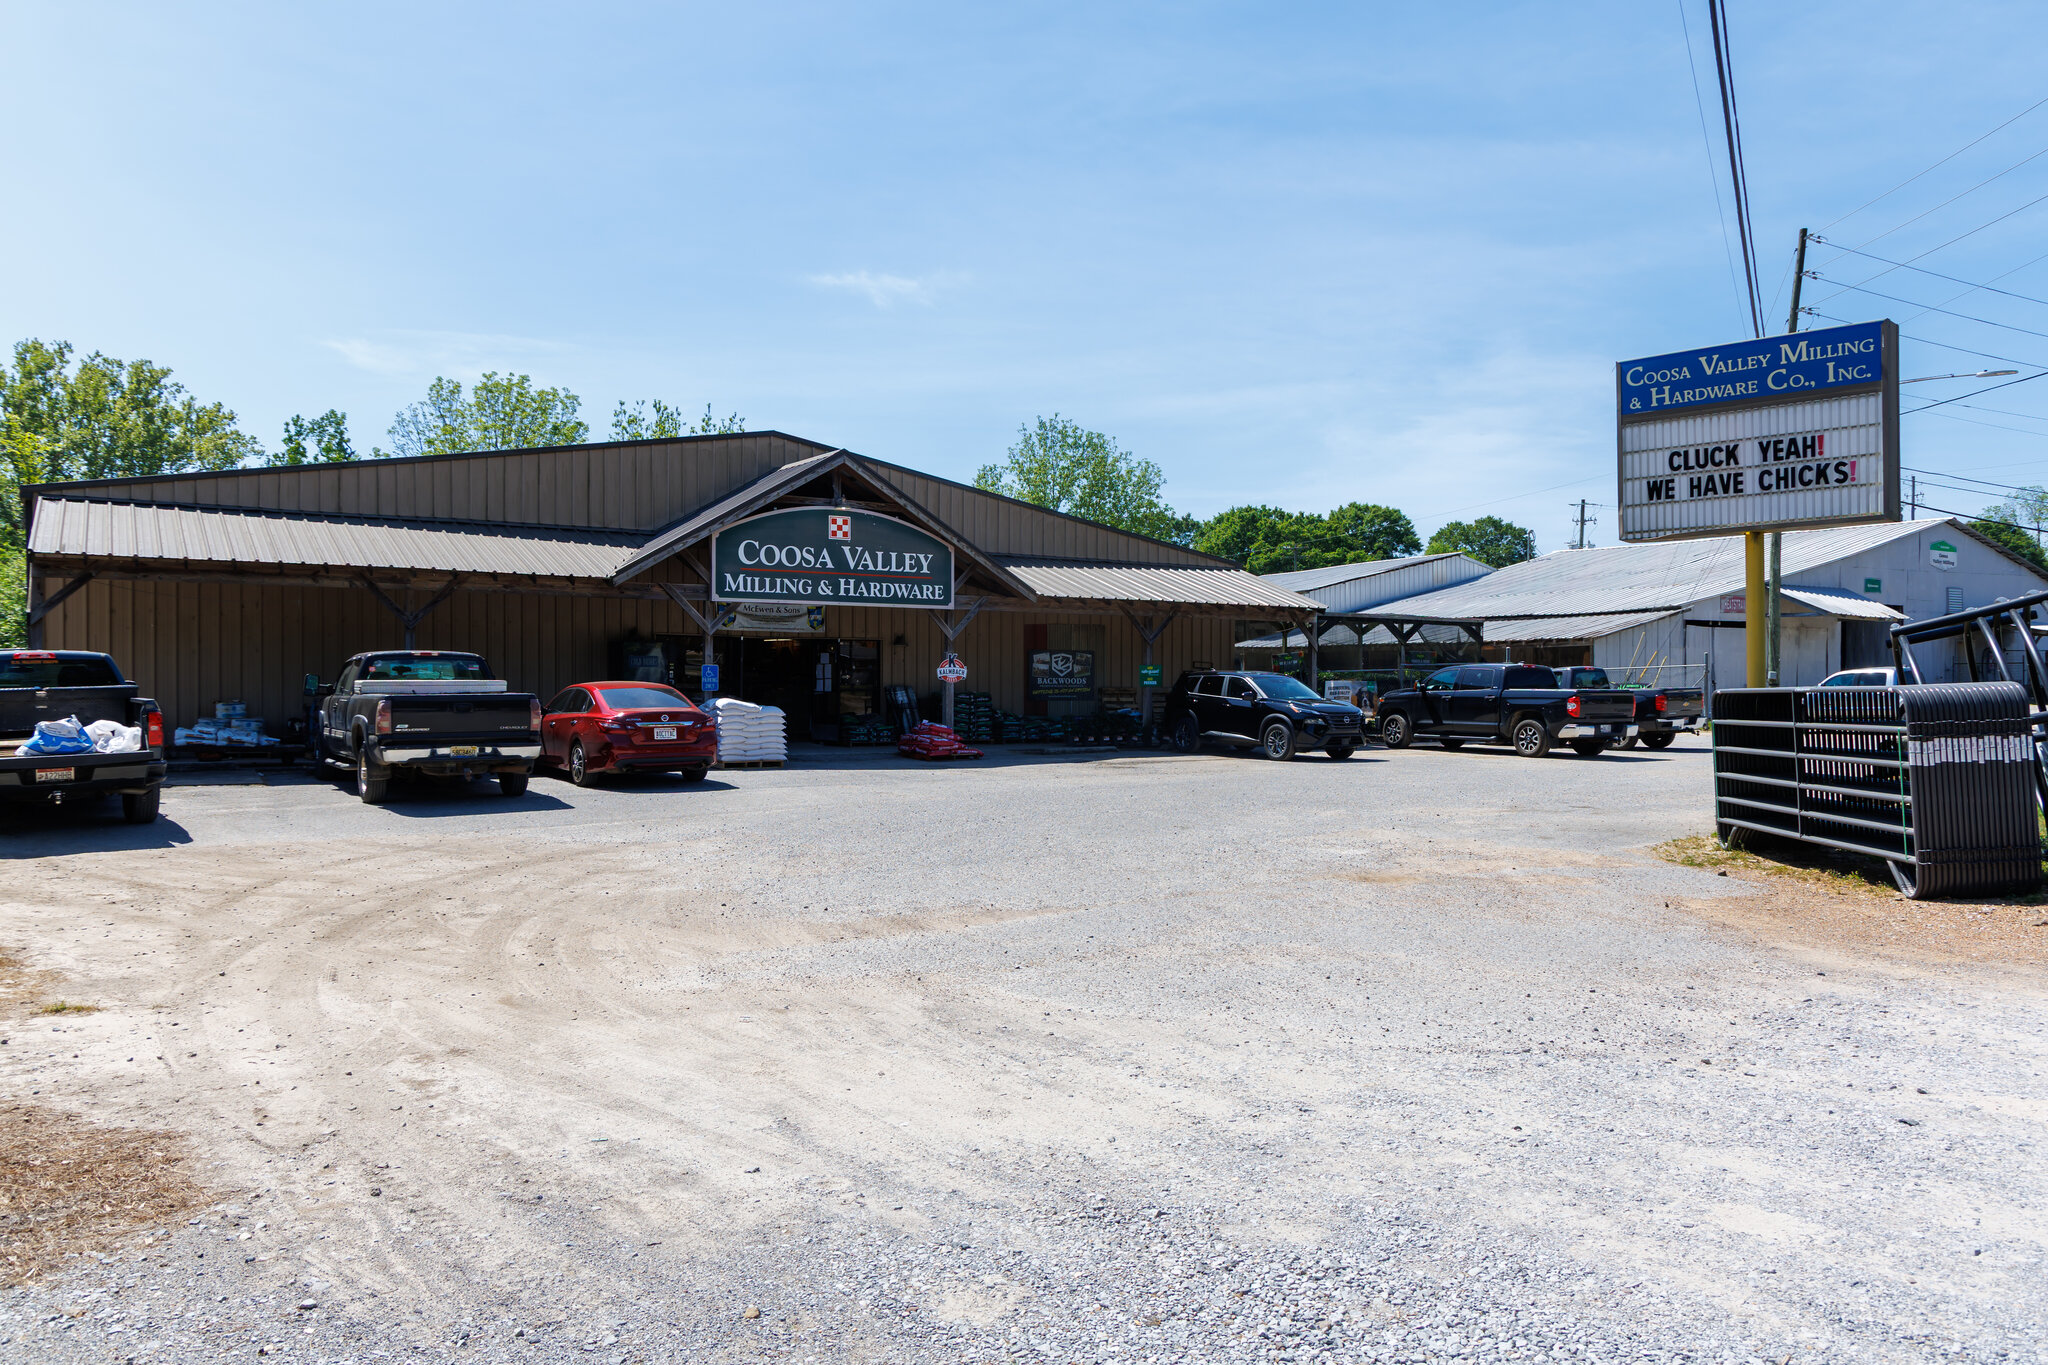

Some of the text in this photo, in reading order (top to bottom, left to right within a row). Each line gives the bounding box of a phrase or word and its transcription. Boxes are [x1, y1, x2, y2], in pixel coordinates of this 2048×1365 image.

[1626, 338, 1875, 386] COOSA VALLEY MILLING
[1629, 396, 1642, 410] &
[1651, 380, 1758, 407] HARDWARE
[1668, 434, 1825, 472] CLUCK YEAH!
[1647, 460, 1857, 501] WE HAVE CHICKS!
[738, 539, 934, 573] COOSA VALLEY
[724, 573, 944, 600] MILLING & HARDWARE
[742, 604, 801, 614] McEwen & Sons
[938, 668, 966, 676] KALMBACH
[1037, 677, 1087, 685] BACKWOODS
